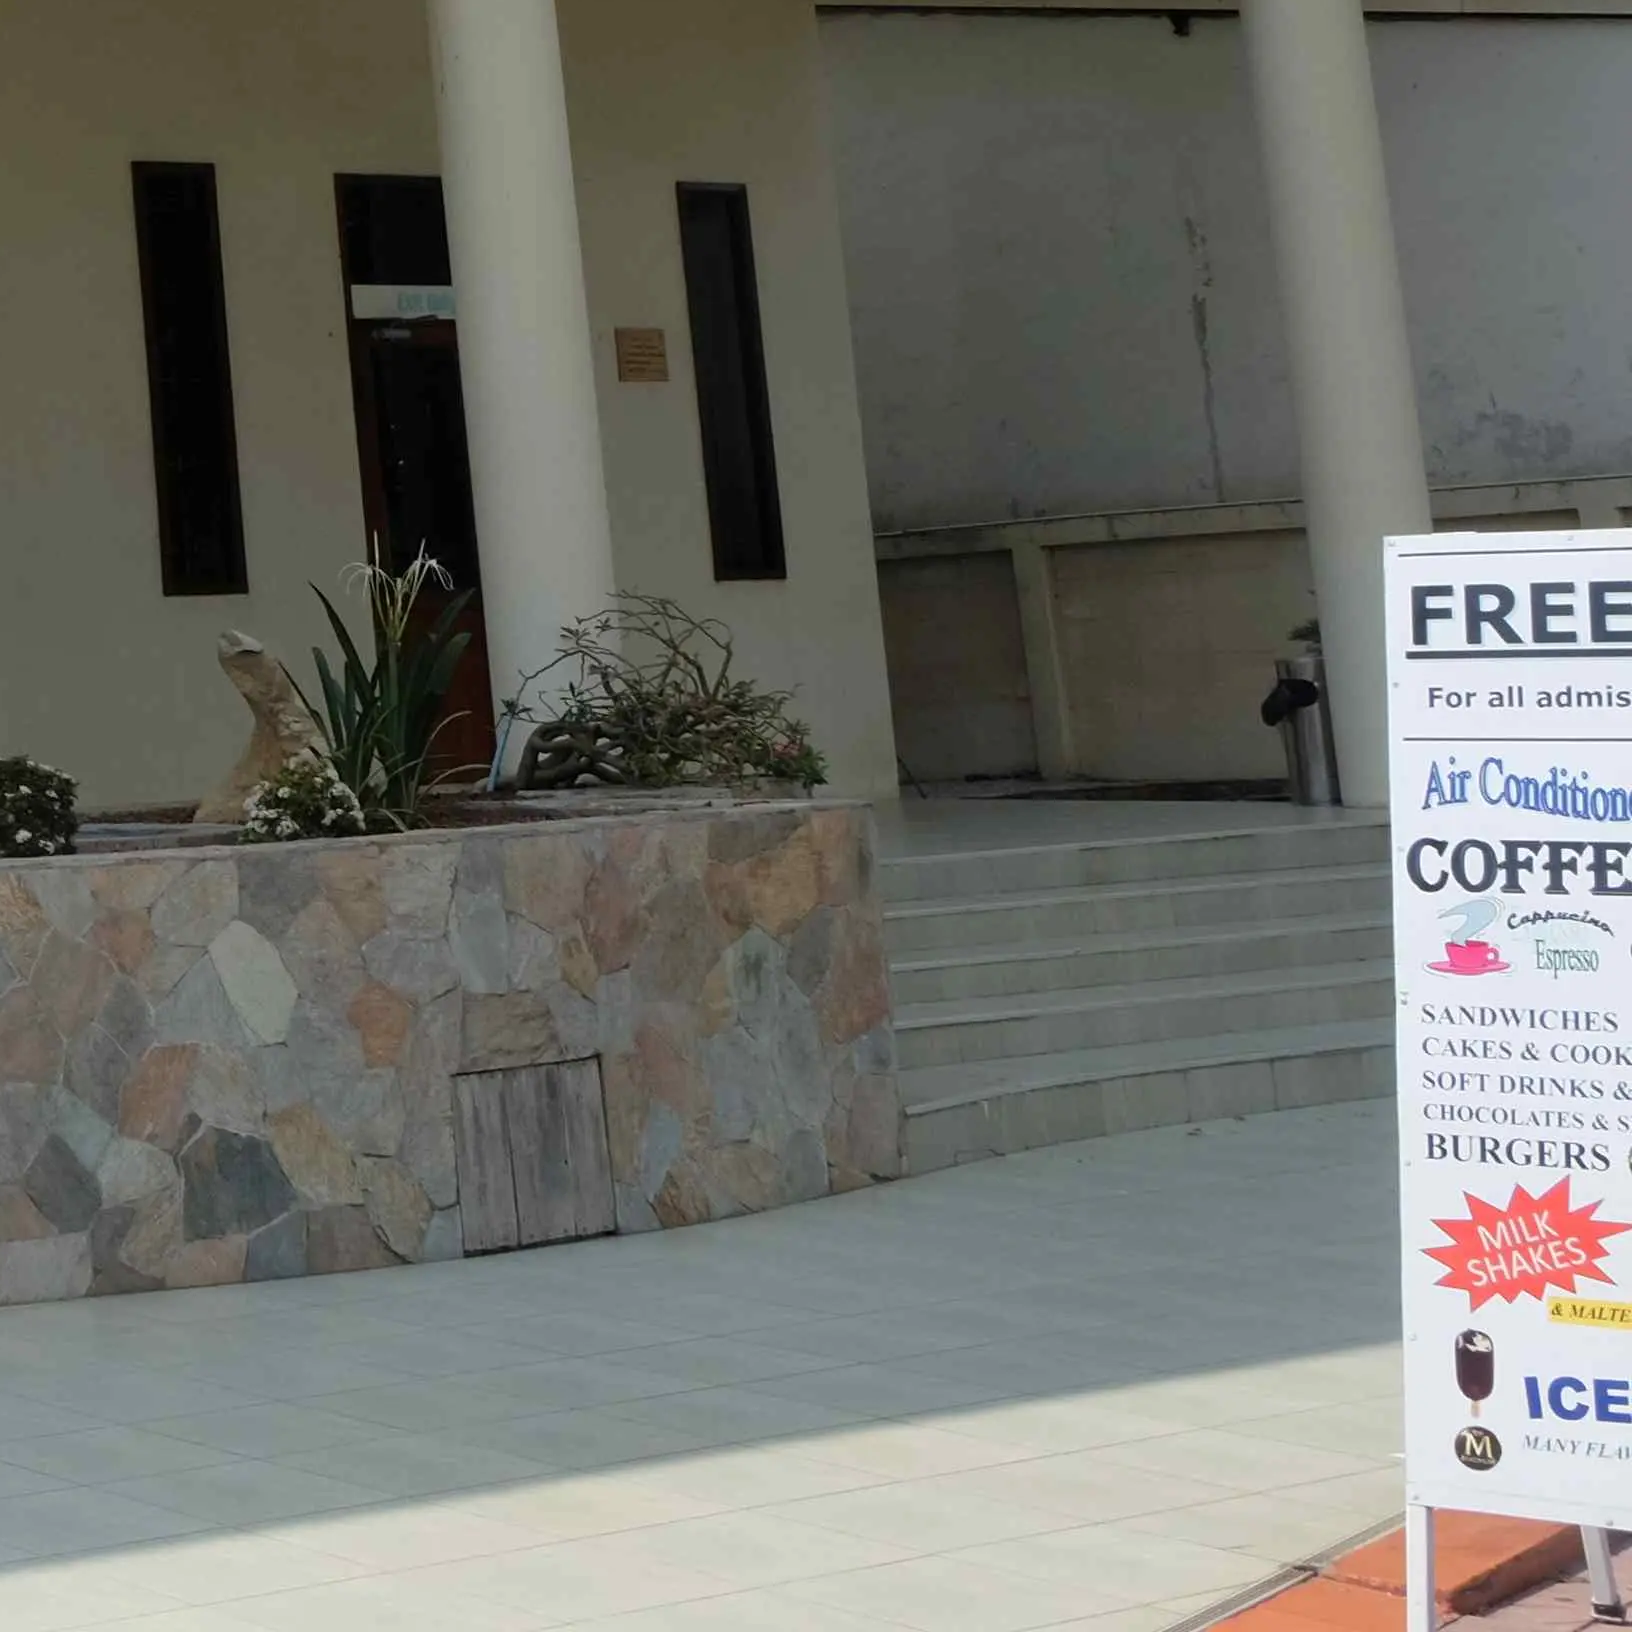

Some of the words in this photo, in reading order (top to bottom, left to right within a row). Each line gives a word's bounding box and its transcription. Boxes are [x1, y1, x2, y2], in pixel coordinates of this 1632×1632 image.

[1410, 580, 1632, 646] FREE
[1428, 686, 1477, 708] For
[1487, 685, 1523, 708] all
[1536, 684, 1632, 709] admis
[1422, 756, 1471, 810] Air
[1480, 757, 1632, 822] Condition
[1406, 838, 1632, 896] COFFE
[1534, 939, 1599, 980] Espresso
[1421, 1003, 1620, 1033] SANDWICHES
[1422, 1036, 1513, 1060] CAKES
[1520, 1041, 1540, 1061] &
[1550, 1043, 1632, 1066] COOK
[1422, 1070, 1491, 1094] SOFT
[1499, 1074, 1604, 1100] DRINKS
[1613, 1080, 1632, 1101] &
[1423, 1102, 1585, 1130] CHOCOLATES
[1592, 1113, 1609, 1131] &
[1425, 1132, 1612, 1172] BURGERS
[1478, 1212, 1557, 1253] MILK
[1466, 1237, 1587, 1289] SHAKES
[1551, 1302, 1563, 1317] &
[1569, 1304, 1632, 1323] MALTE
[1523, 1375, 1632, 1424] ICE
[1523, 1434, 1583, 1455] MANY
